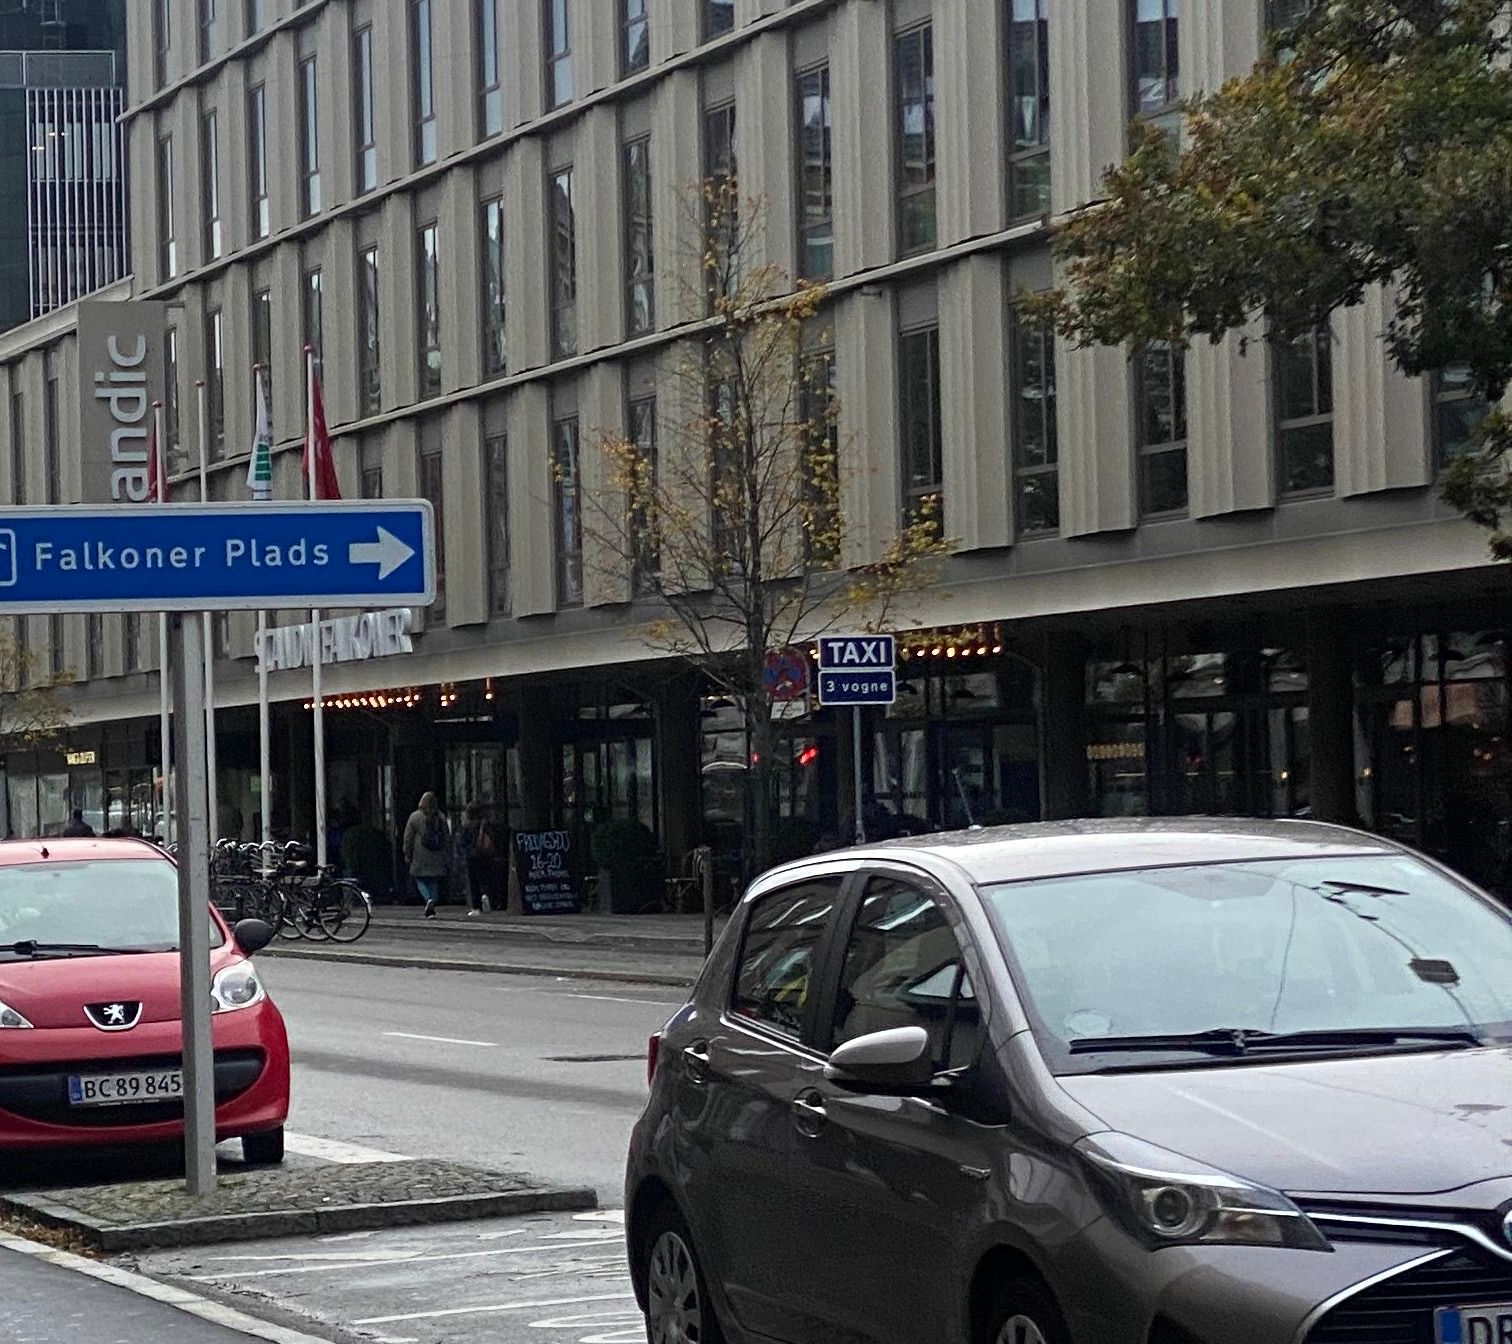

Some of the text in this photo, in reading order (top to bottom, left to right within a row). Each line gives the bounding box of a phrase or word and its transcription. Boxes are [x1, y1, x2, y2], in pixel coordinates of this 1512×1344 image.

[34, 538, 206, 571] Falkoner
[225, 537, 330, 567] Plads
[828, 641, 886, 664] TAXI
[826, 680, 888, 694] 3 vogne
[84, 1074, 181, 1098] BC 89 845
